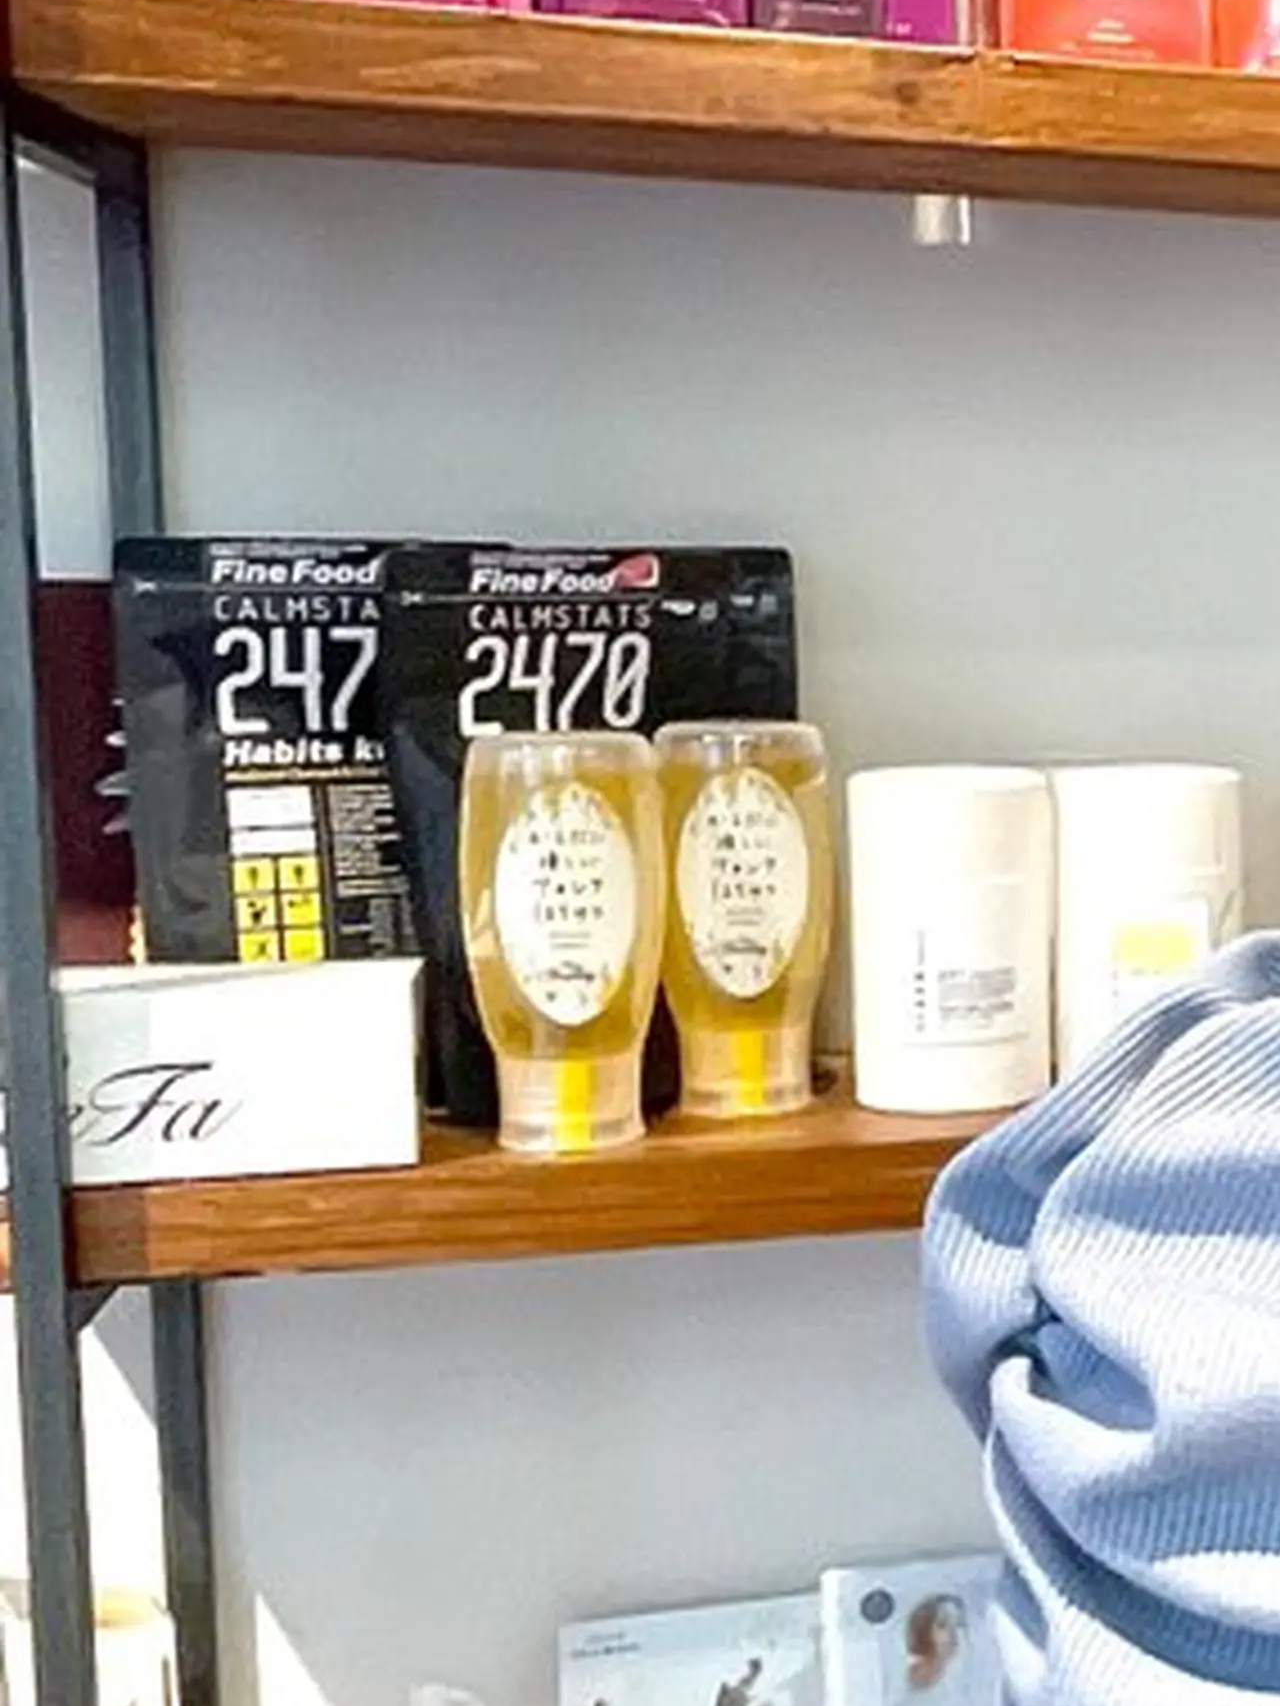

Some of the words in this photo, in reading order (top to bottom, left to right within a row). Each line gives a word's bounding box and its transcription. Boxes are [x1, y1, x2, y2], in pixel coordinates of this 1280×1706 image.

[213, 595, 380, 622] CALMSTA
[468, 602, 652, 629] CALMSTATS
[213, 626, 380, 735] 247
[458, 632, 652, 736] 2470
[222, 736, 344, 768] Habits
